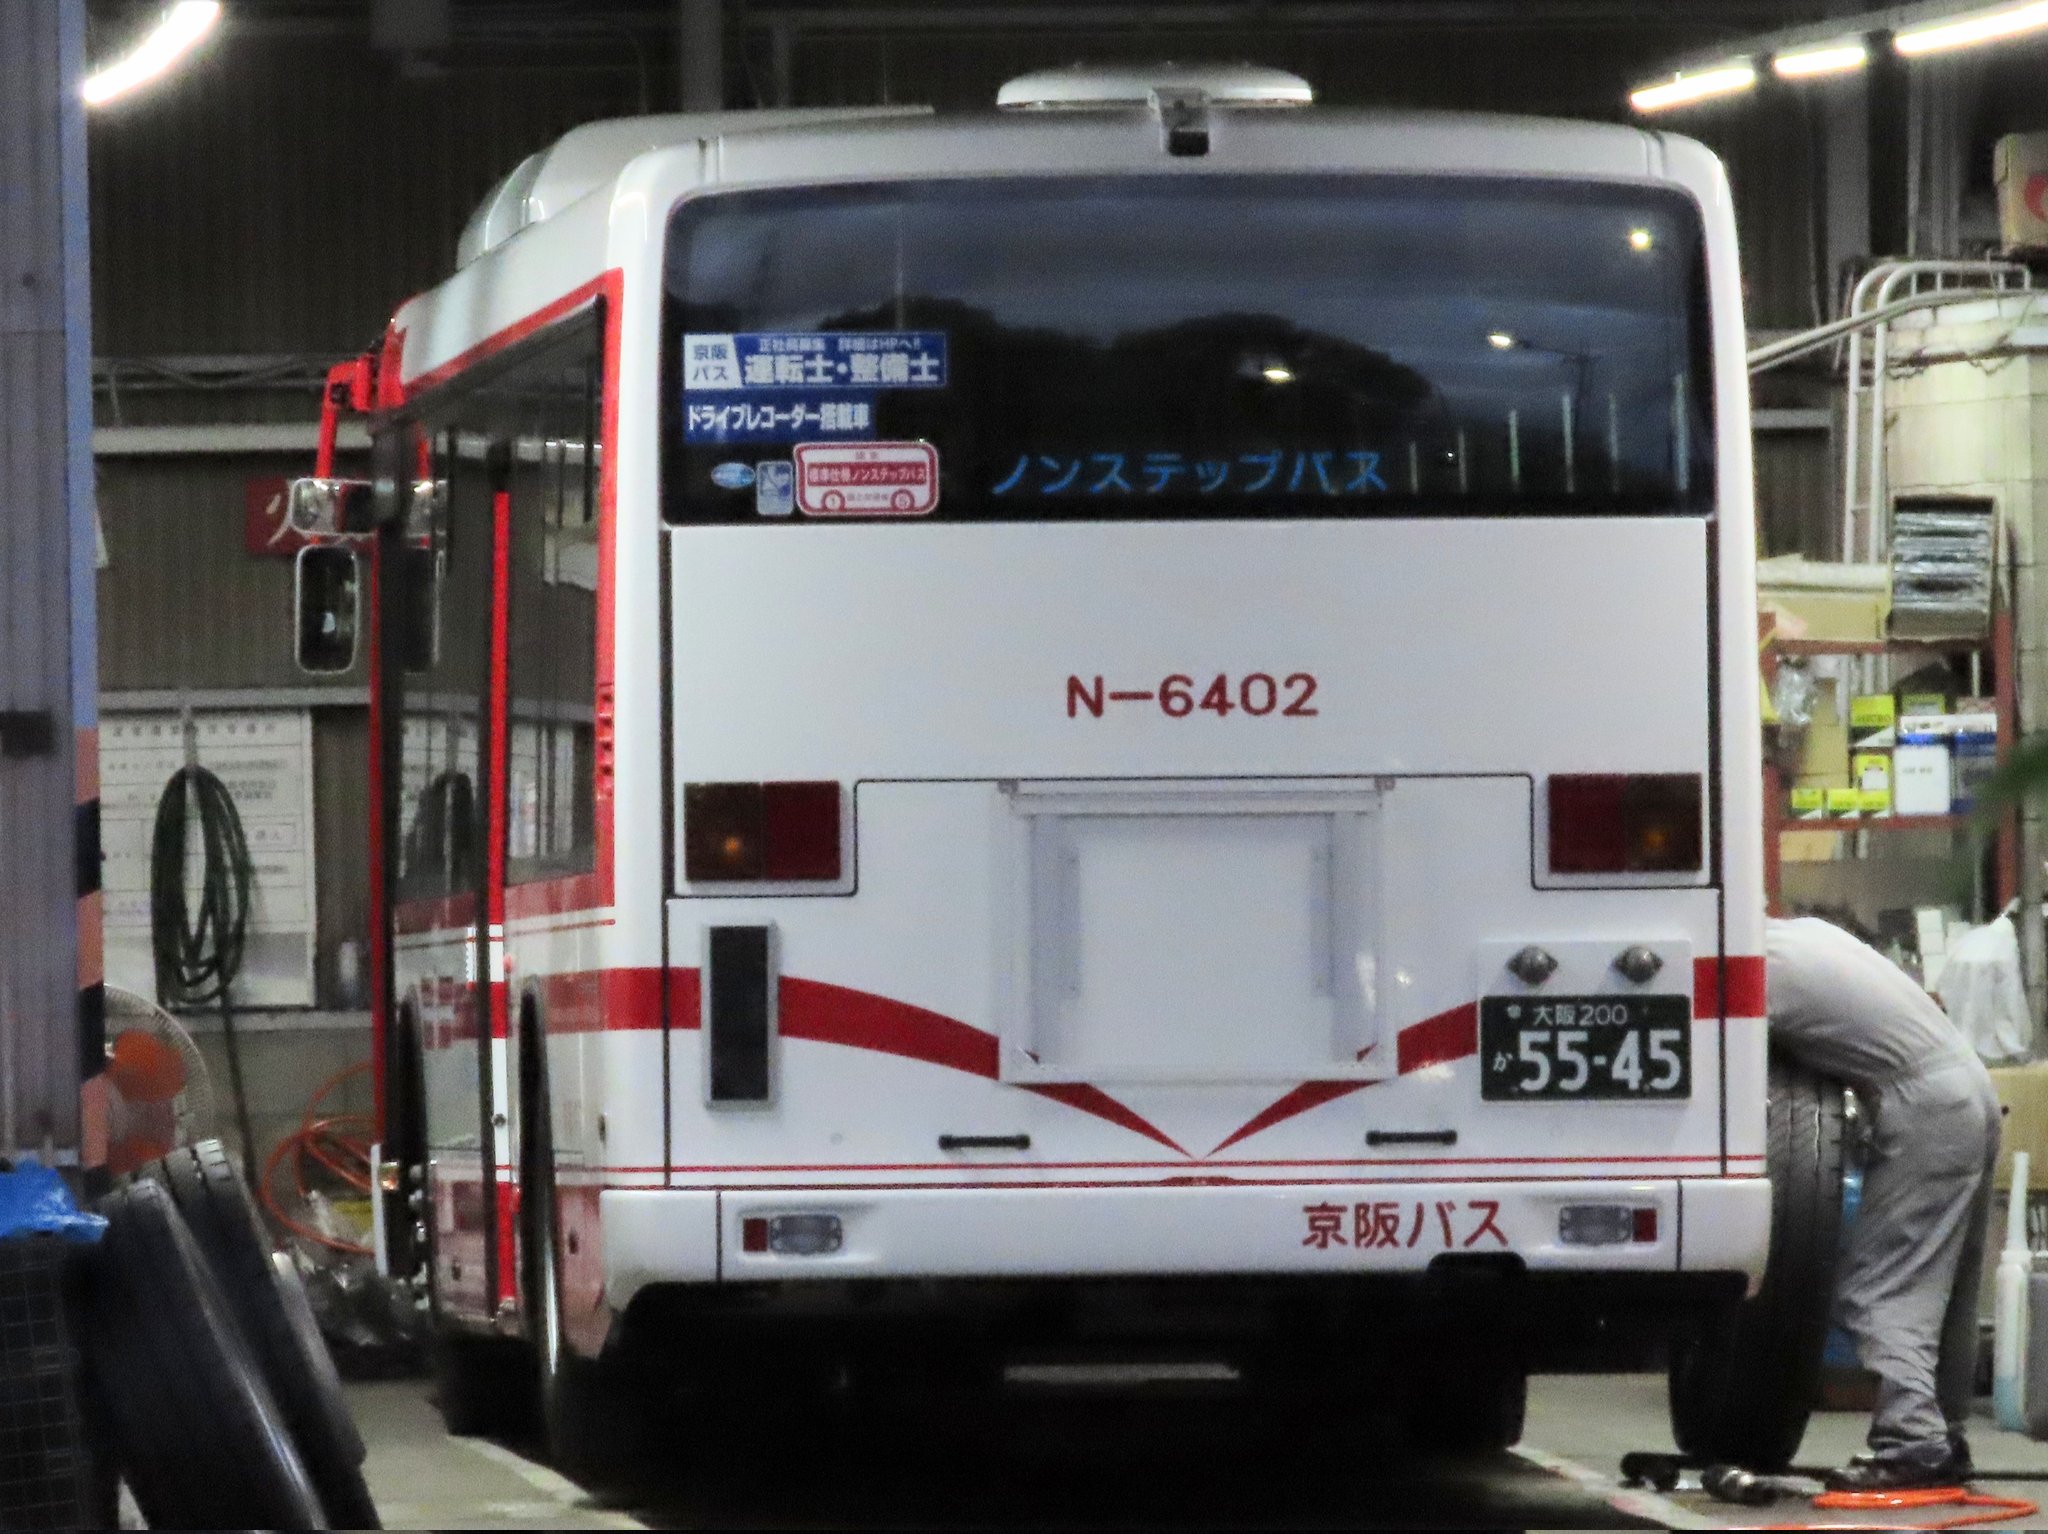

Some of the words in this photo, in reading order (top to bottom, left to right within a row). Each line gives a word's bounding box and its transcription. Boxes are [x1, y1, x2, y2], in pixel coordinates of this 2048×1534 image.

[693, 344, 728, 361] 京阪
[744, 352, 941, 384] 運転士・整備士
[692, 365, 728, 382] バス
[688, 402, 870, 432] ドライブレコーダー搭載車
[990, 450, 1388, 496] ノンステップバス
[1066, 672, 1320, 719] N-6402
[1518, 1029, 1682, 1093] 55-45
[1301, 1199, 1509, 1250] 京阪バス
